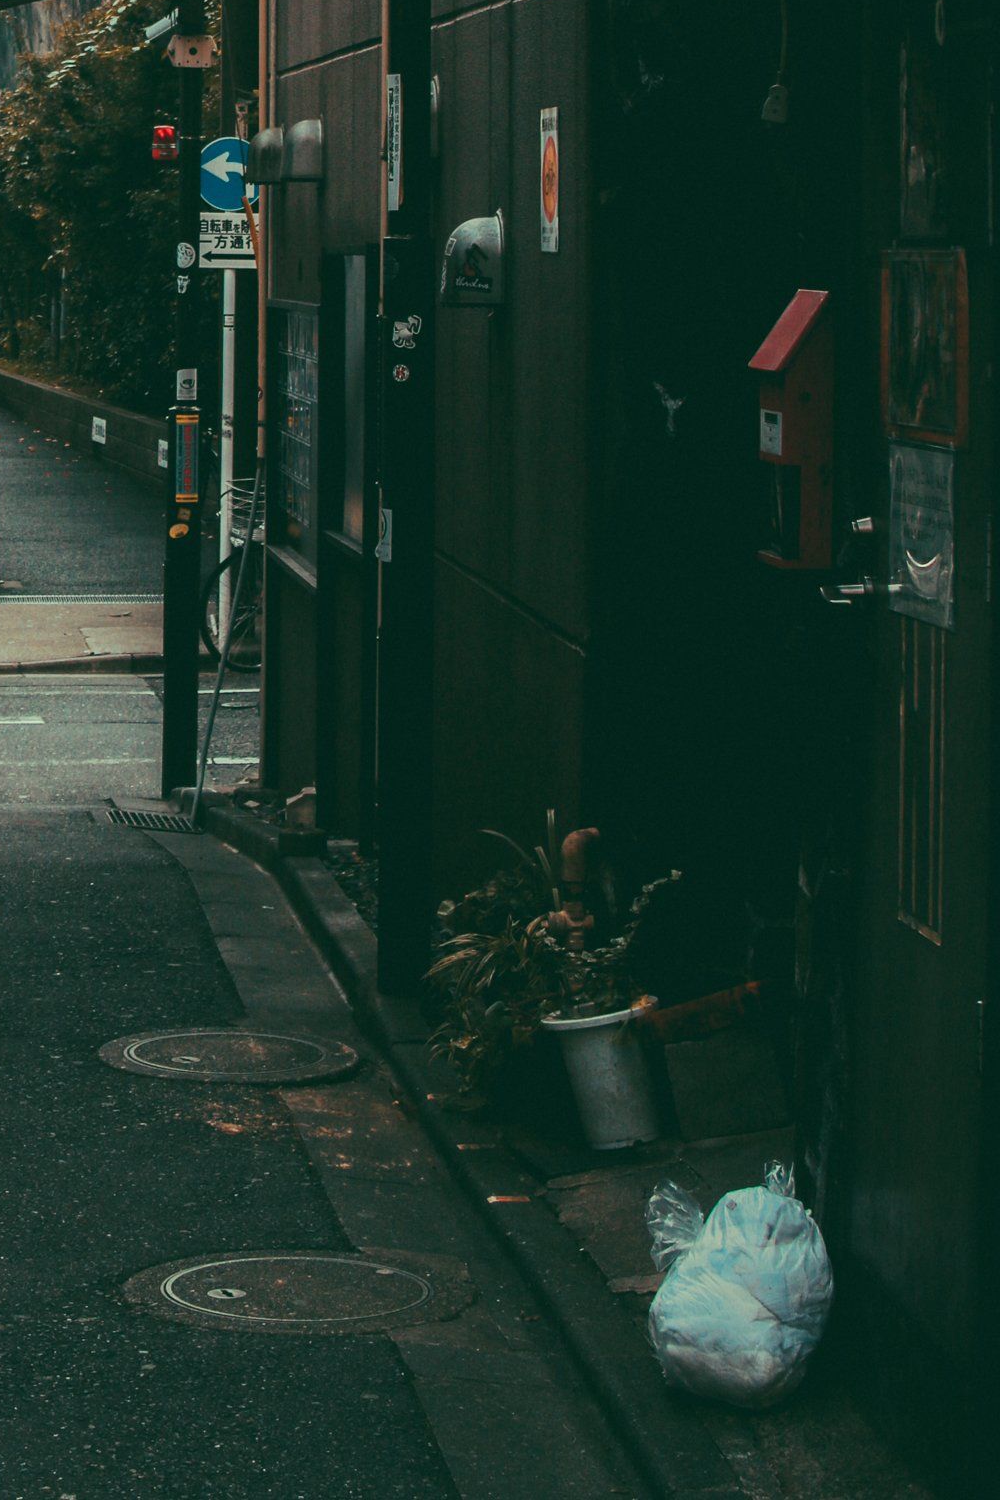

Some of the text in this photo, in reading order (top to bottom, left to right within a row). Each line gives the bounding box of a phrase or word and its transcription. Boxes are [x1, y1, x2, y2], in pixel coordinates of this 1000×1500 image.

[200, 219, 259, 233] 自転車を除
